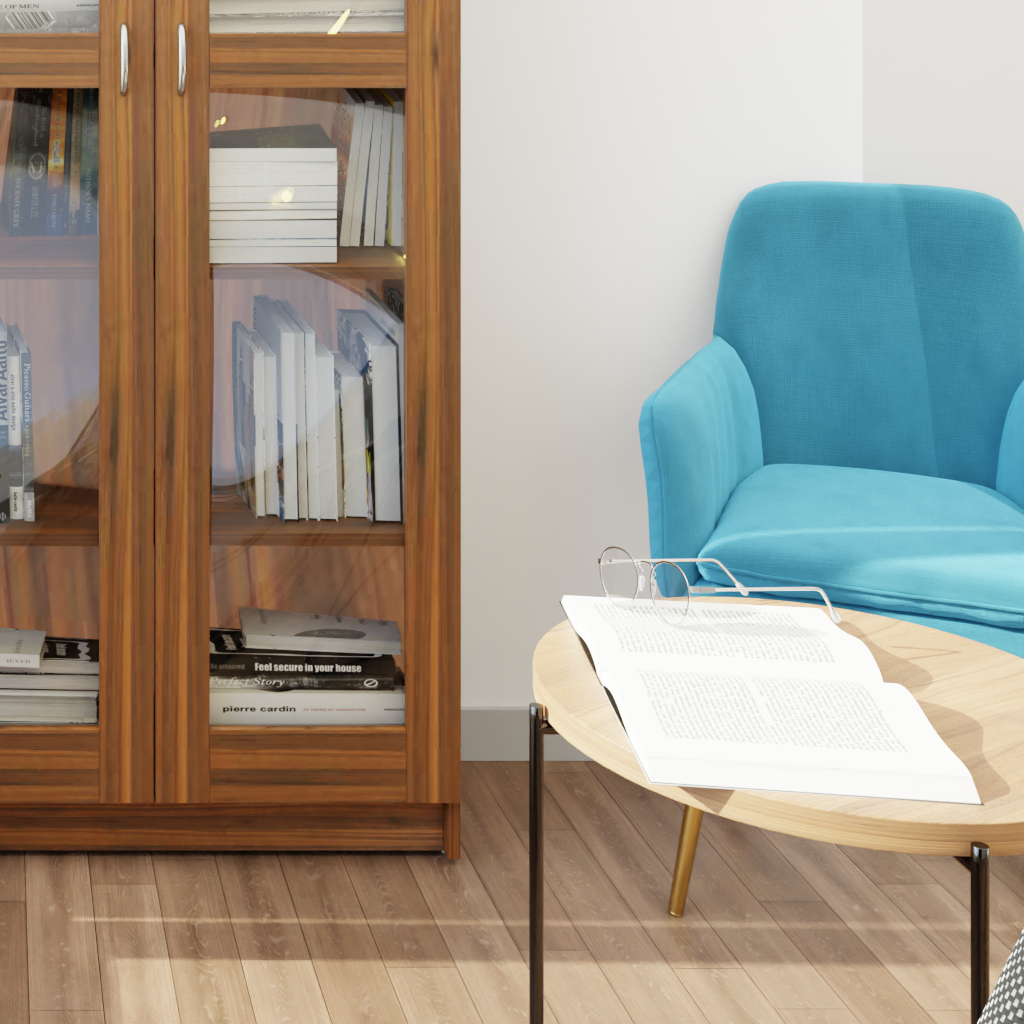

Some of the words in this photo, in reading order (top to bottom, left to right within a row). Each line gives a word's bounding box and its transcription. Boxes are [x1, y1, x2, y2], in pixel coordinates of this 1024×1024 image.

[254, 663, 272, 671] Feel
[273, 663, 303, 672] secure
[305, 663, 313, 672] in
[314, 664, 334, 673] your
[335, 664, 362, 673] house
[210, 677, 249, 686] Perfect
[252, 677, 285, 687] Story
